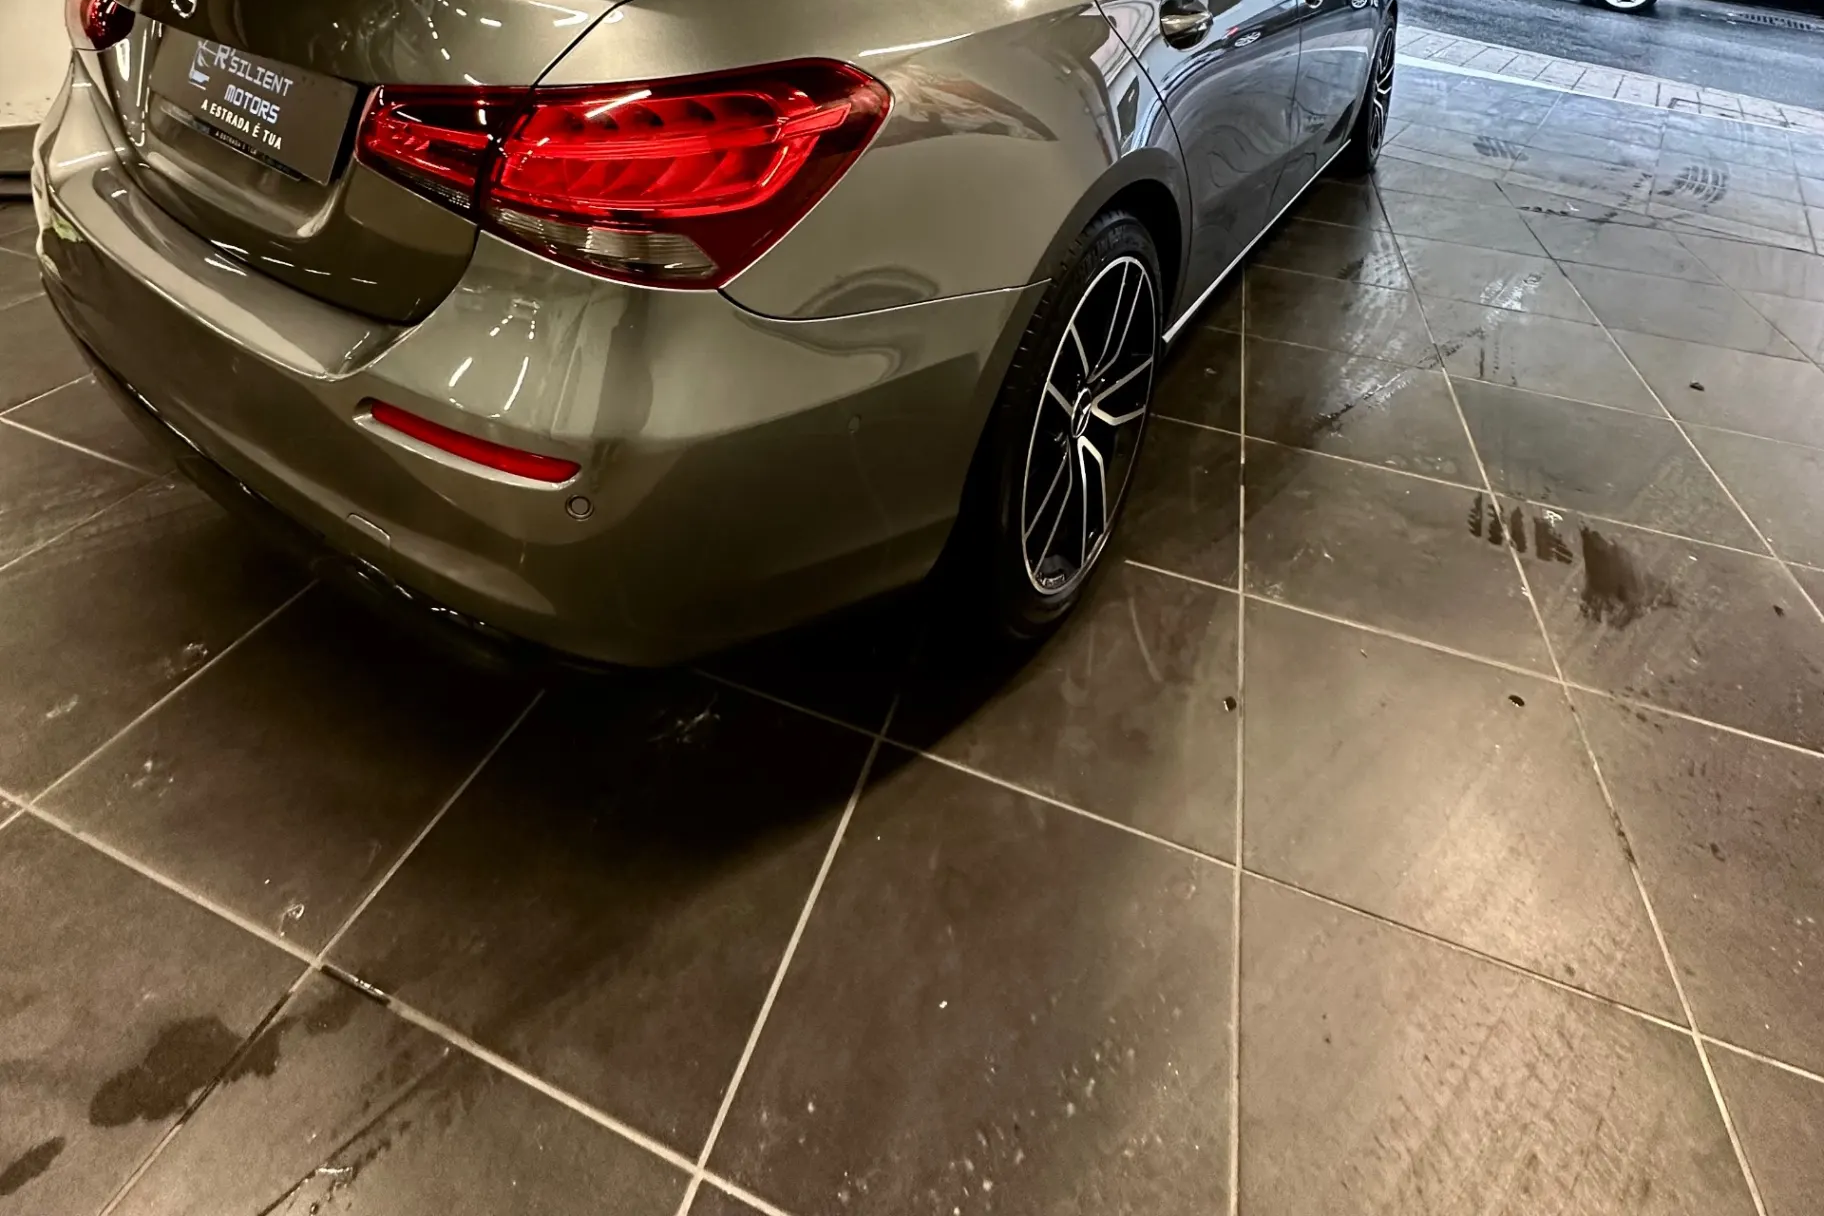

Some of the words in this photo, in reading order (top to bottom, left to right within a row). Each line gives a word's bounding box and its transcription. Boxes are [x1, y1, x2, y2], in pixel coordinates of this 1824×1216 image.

[214, 44, 293, 96] R'SILIENT
[201, 98, 209, 110] A
[209, 103, 250, 133] ESTRADA
[251, 123, 261, 137] É
[262, 130, 282, 150] TUA
[224, 84, 280, 124] MOTORS
